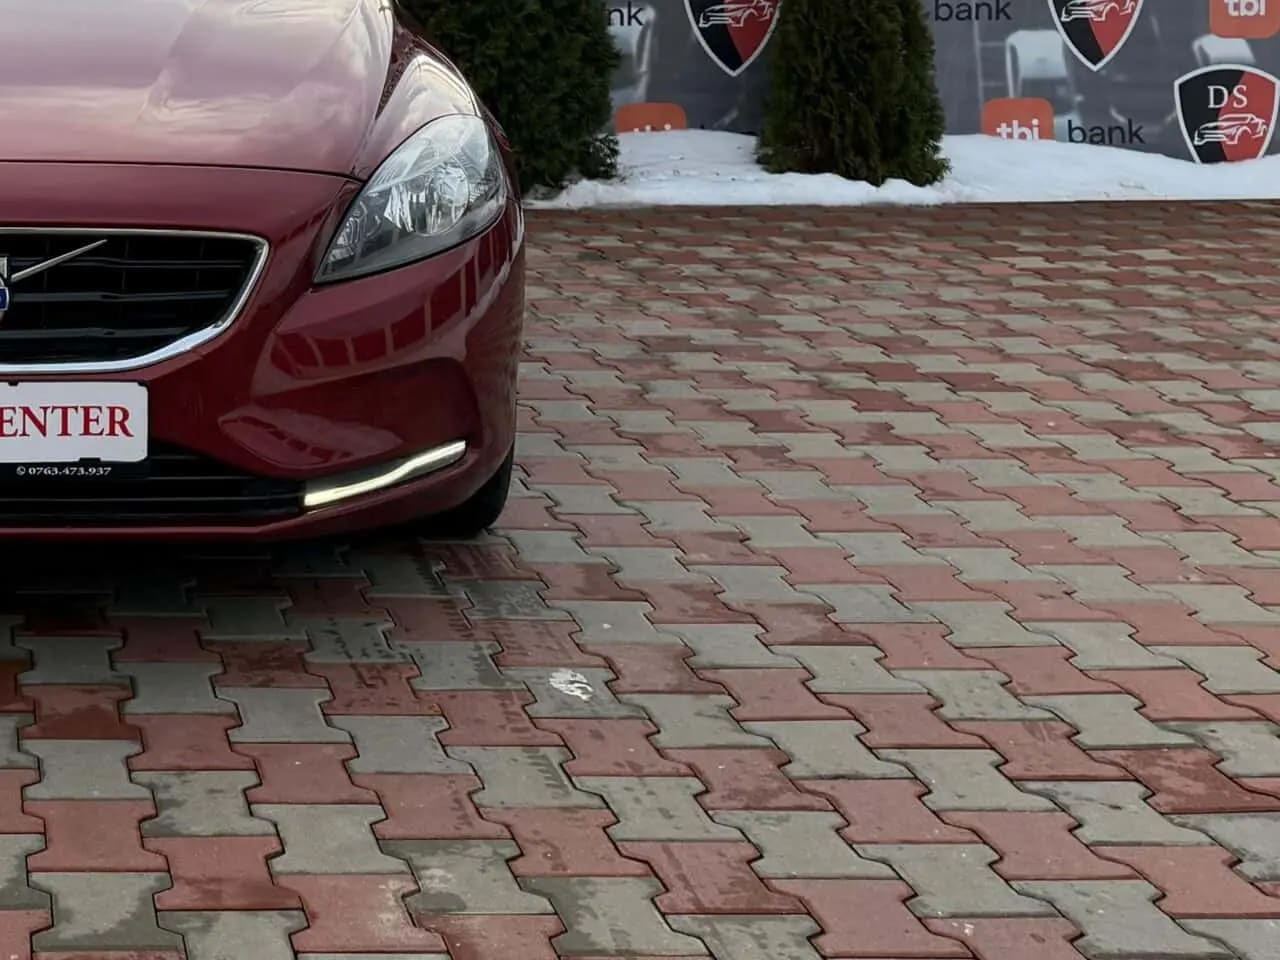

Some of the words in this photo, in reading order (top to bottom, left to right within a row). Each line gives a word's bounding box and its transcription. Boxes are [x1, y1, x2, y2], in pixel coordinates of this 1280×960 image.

[607, 0, 644, 26] nk
[1207, 85, 1249, 109] DS
[1067, 118, 1145, 145] bank
